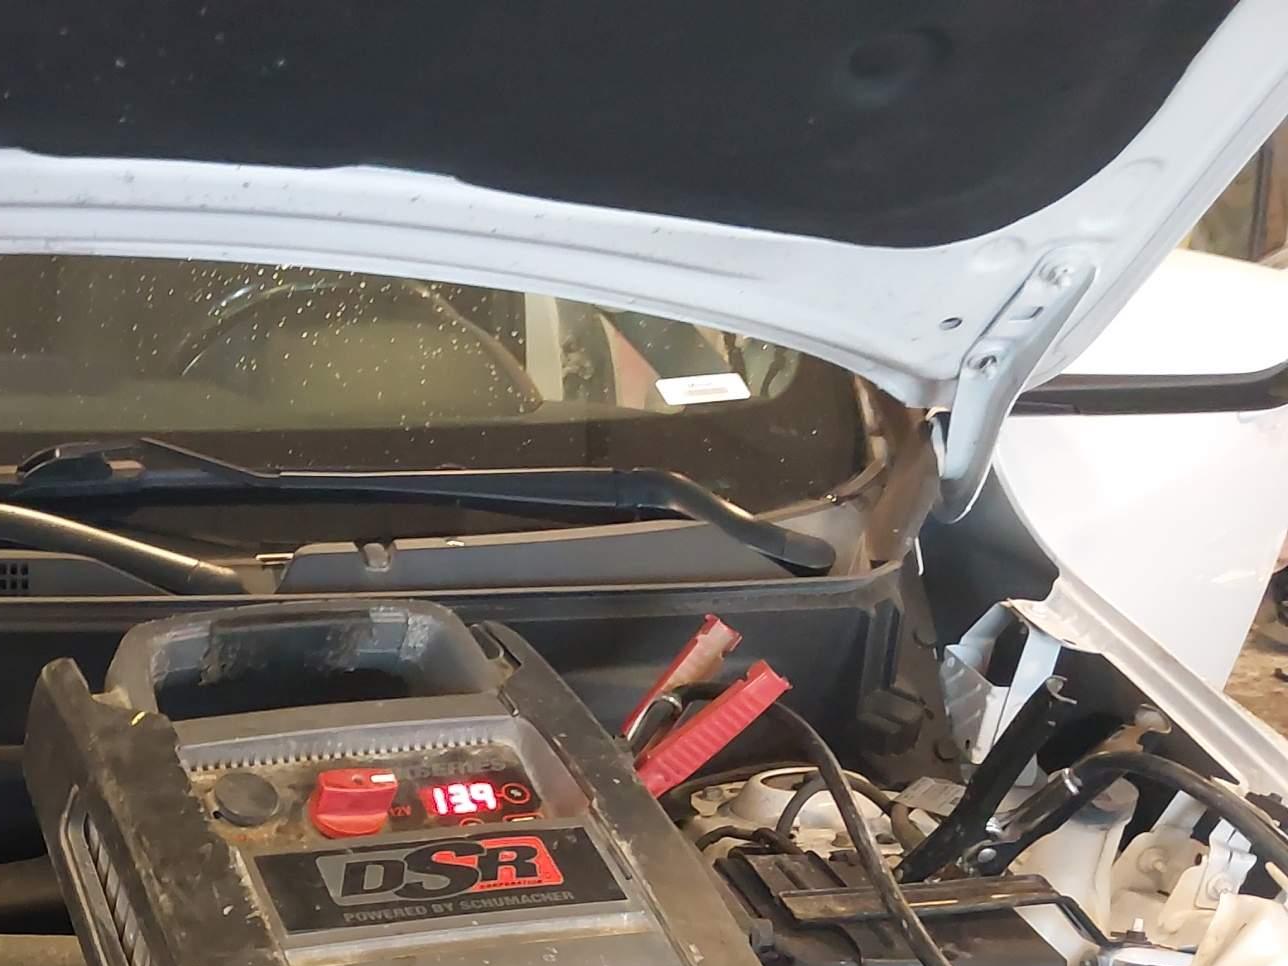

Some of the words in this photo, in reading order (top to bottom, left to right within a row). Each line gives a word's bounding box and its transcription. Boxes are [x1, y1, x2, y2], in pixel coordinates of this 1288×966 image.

[340, 841, 539, 898] DSR
[343, 905, 428, 923] POWERED
[432, 902, 454, 914] BY
